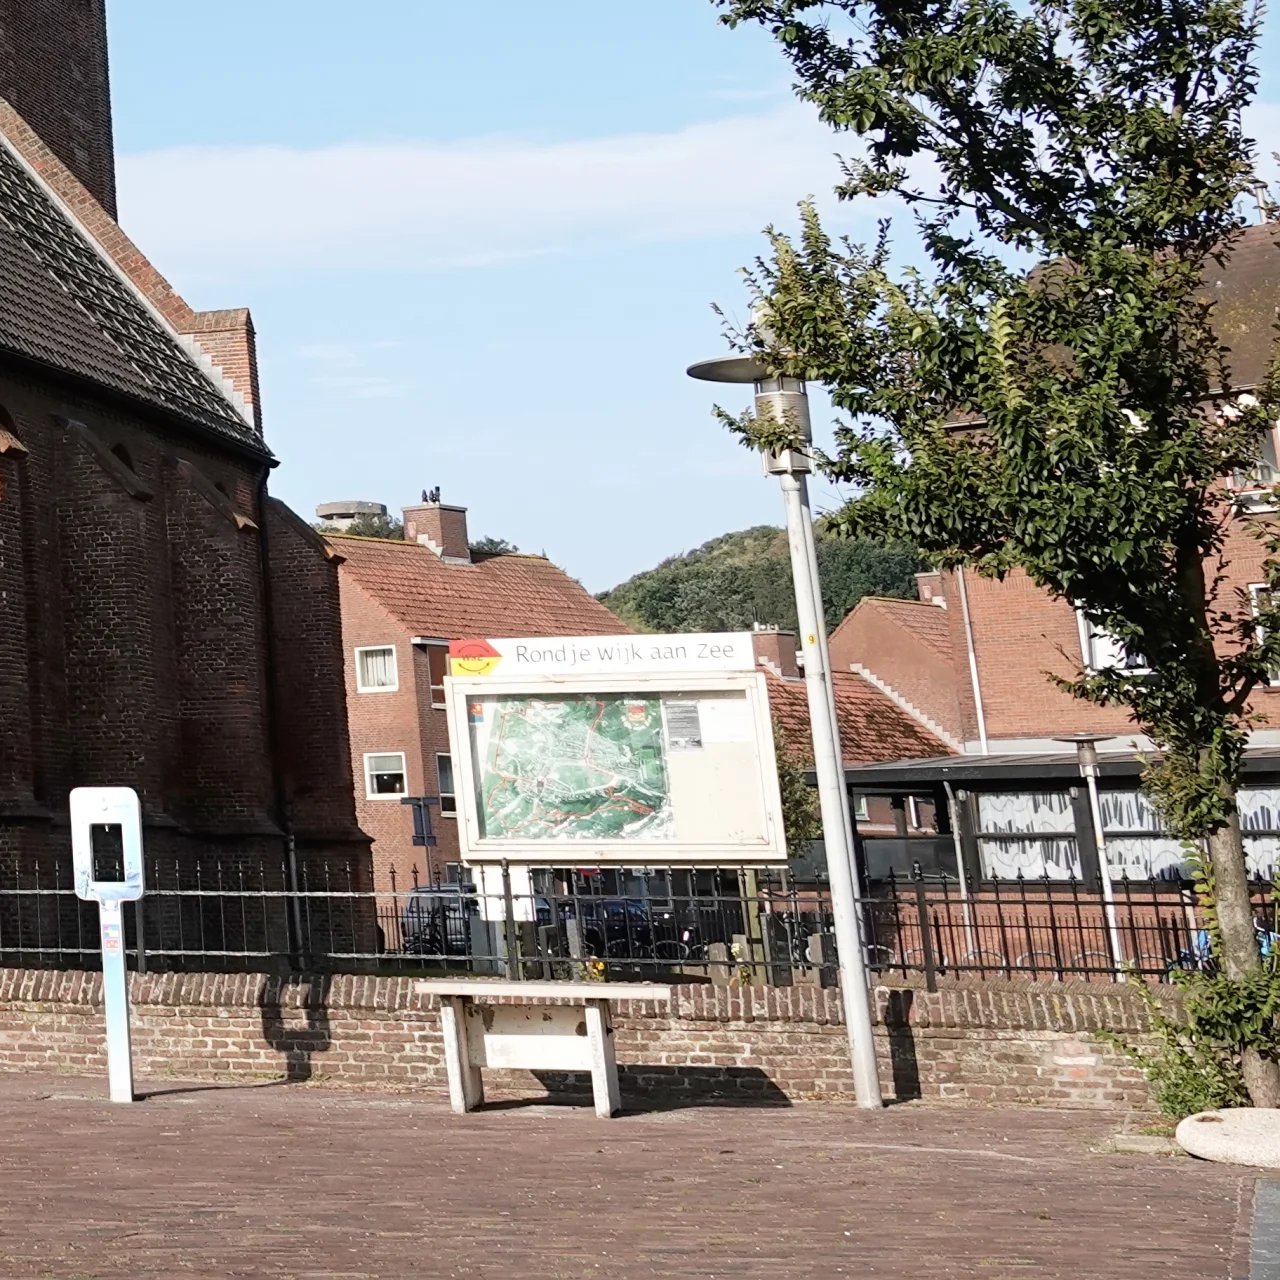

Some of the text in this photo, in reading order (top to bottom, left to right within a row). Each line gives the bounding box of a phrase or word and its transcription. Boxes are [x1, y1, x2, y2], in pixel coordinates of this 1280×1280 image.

[516, 644, 590, 666] Rondje
[650, 645, 687, 660] aan
[697, 643, 735, 659] Zee
